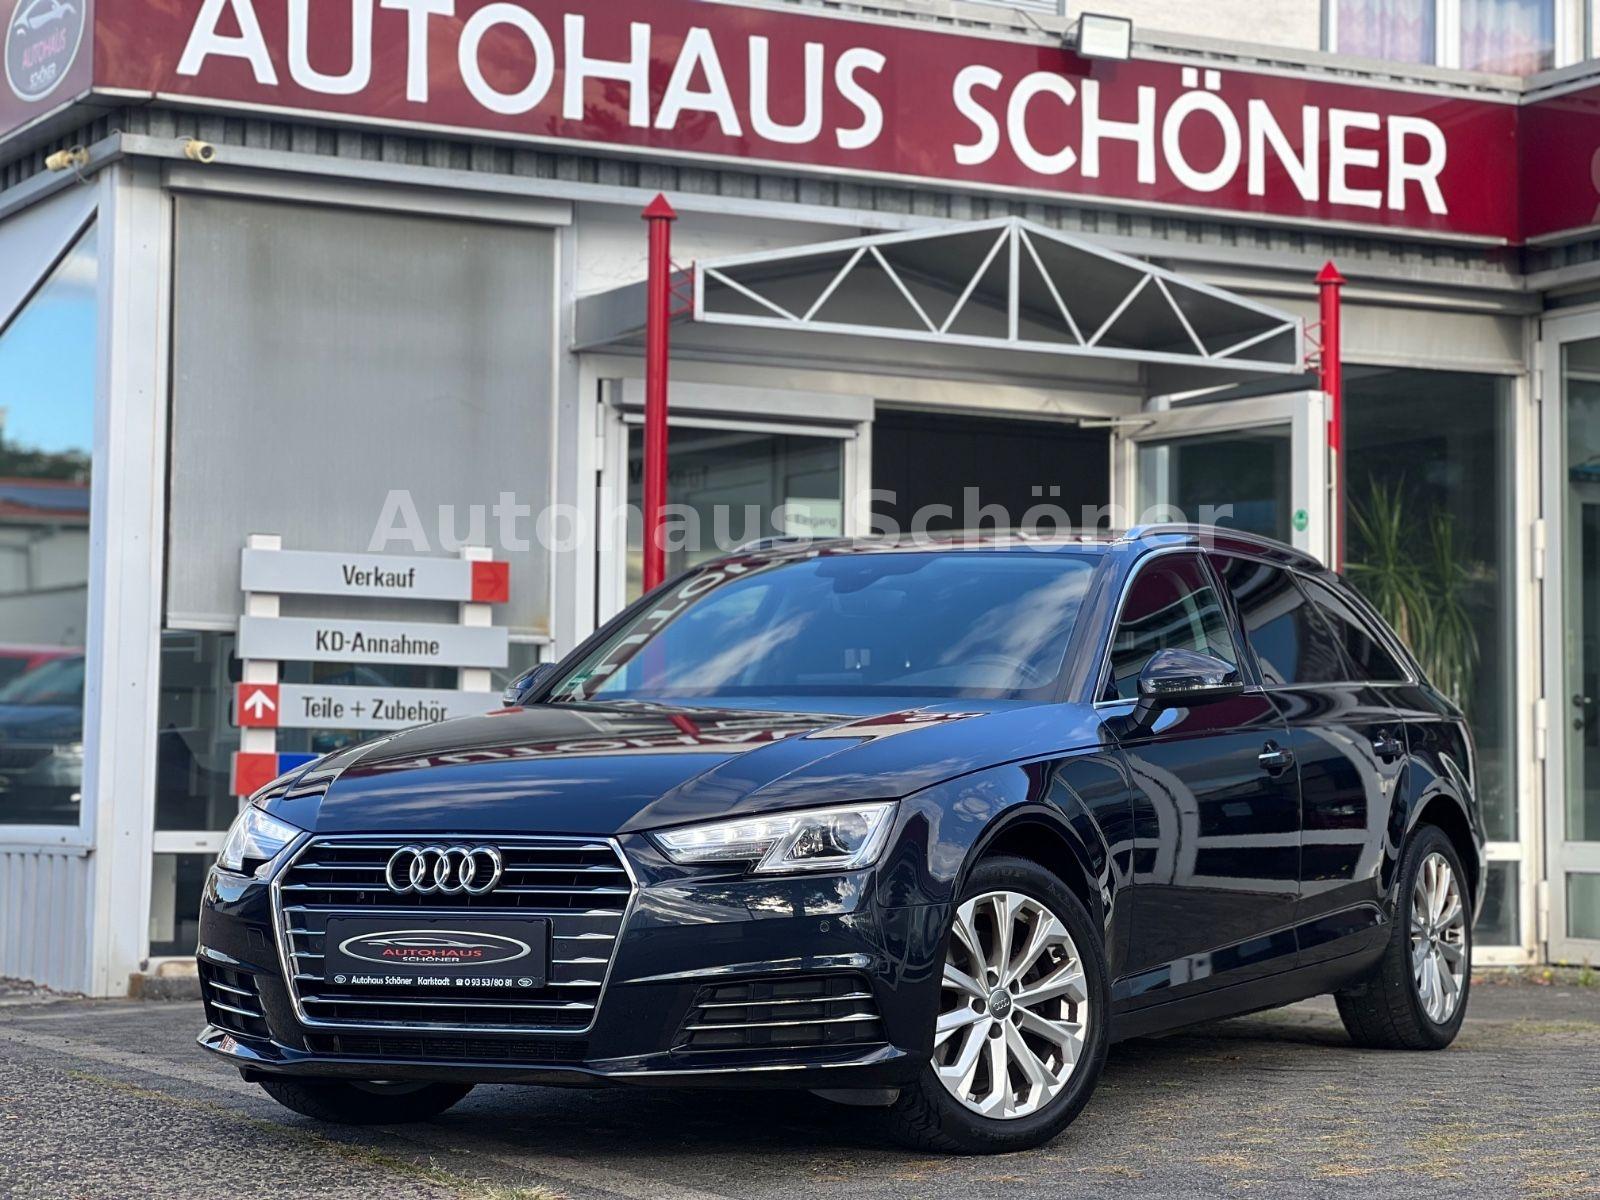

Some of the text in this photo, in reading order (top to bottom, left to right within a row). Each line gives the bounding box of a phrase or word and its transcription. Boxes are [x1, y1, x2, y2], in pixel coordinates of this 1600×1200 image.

[176, 0, 1448, 215] AUTOHAUS SCHÖNER
[342, 564, 416, 589] Verkauf
[315, 629, 440, 656] KD-Annahme
[302, 696, 344, 719] Teile
[372, 698, 449, 723] Zubehör
[382, 948, 482, 958] AUTOHAUS
[351, 975, 384, 985] Autohaus
[385, 975, 413, 986] Schöner
[417, 976, 451, 987] Karlstadt
